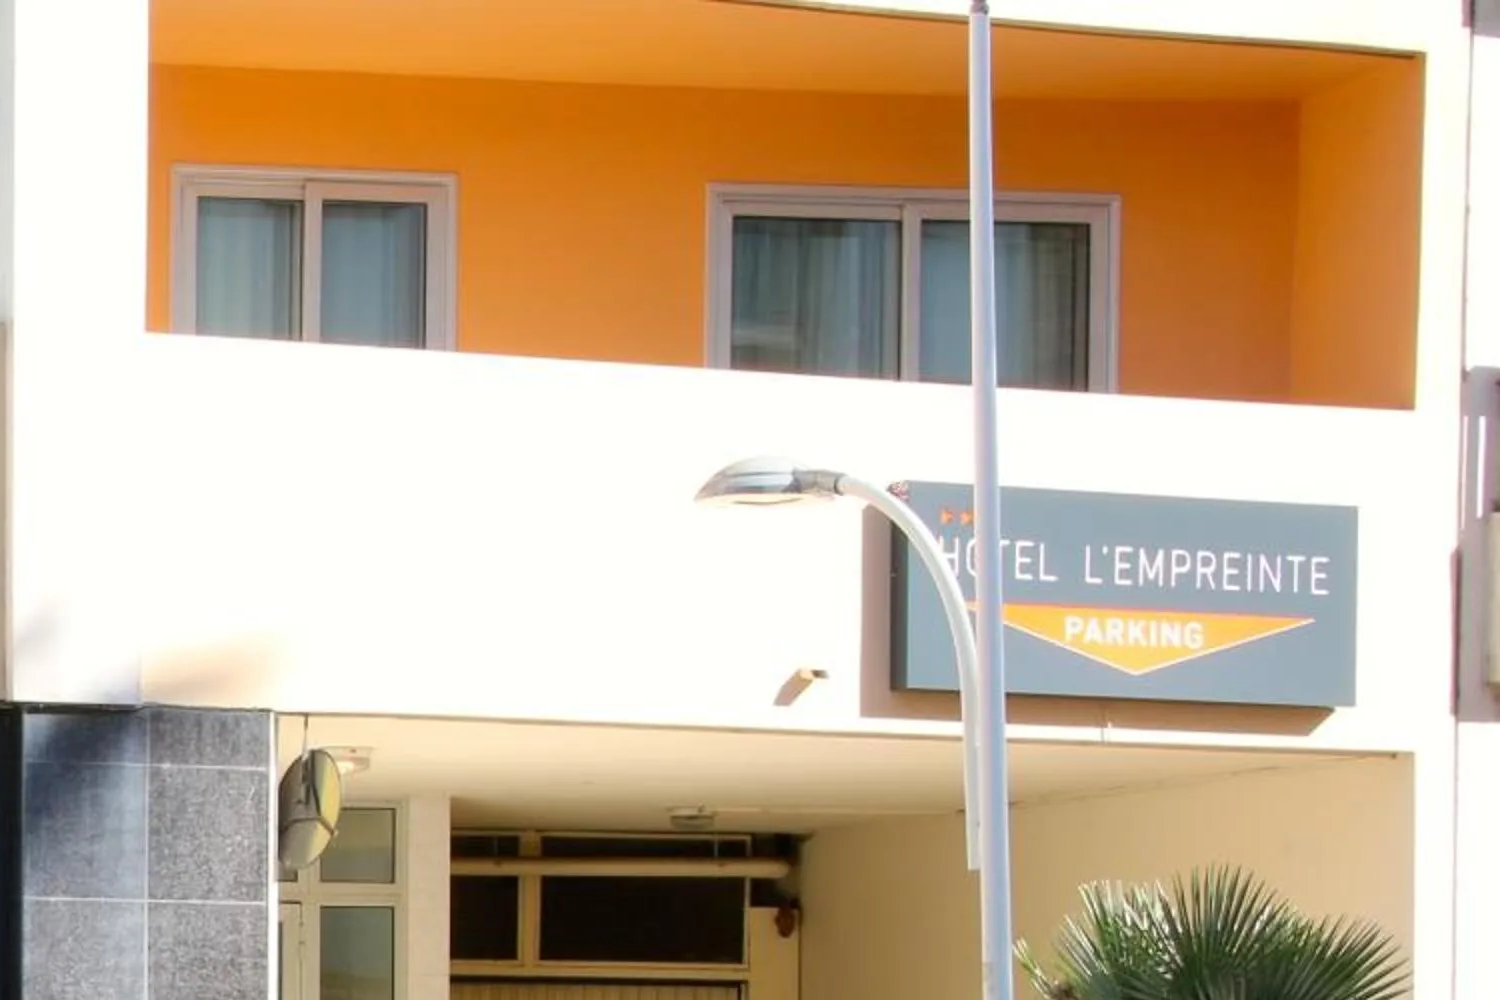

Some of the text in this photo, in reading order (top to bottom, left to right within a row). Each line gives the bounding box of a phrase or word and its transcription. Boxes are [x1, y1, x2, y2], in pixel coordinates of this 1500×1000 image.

[937, 535, 1331, 596] HEL L'EMPREINTE
[1064, 615, 1204, 650] PARKING
